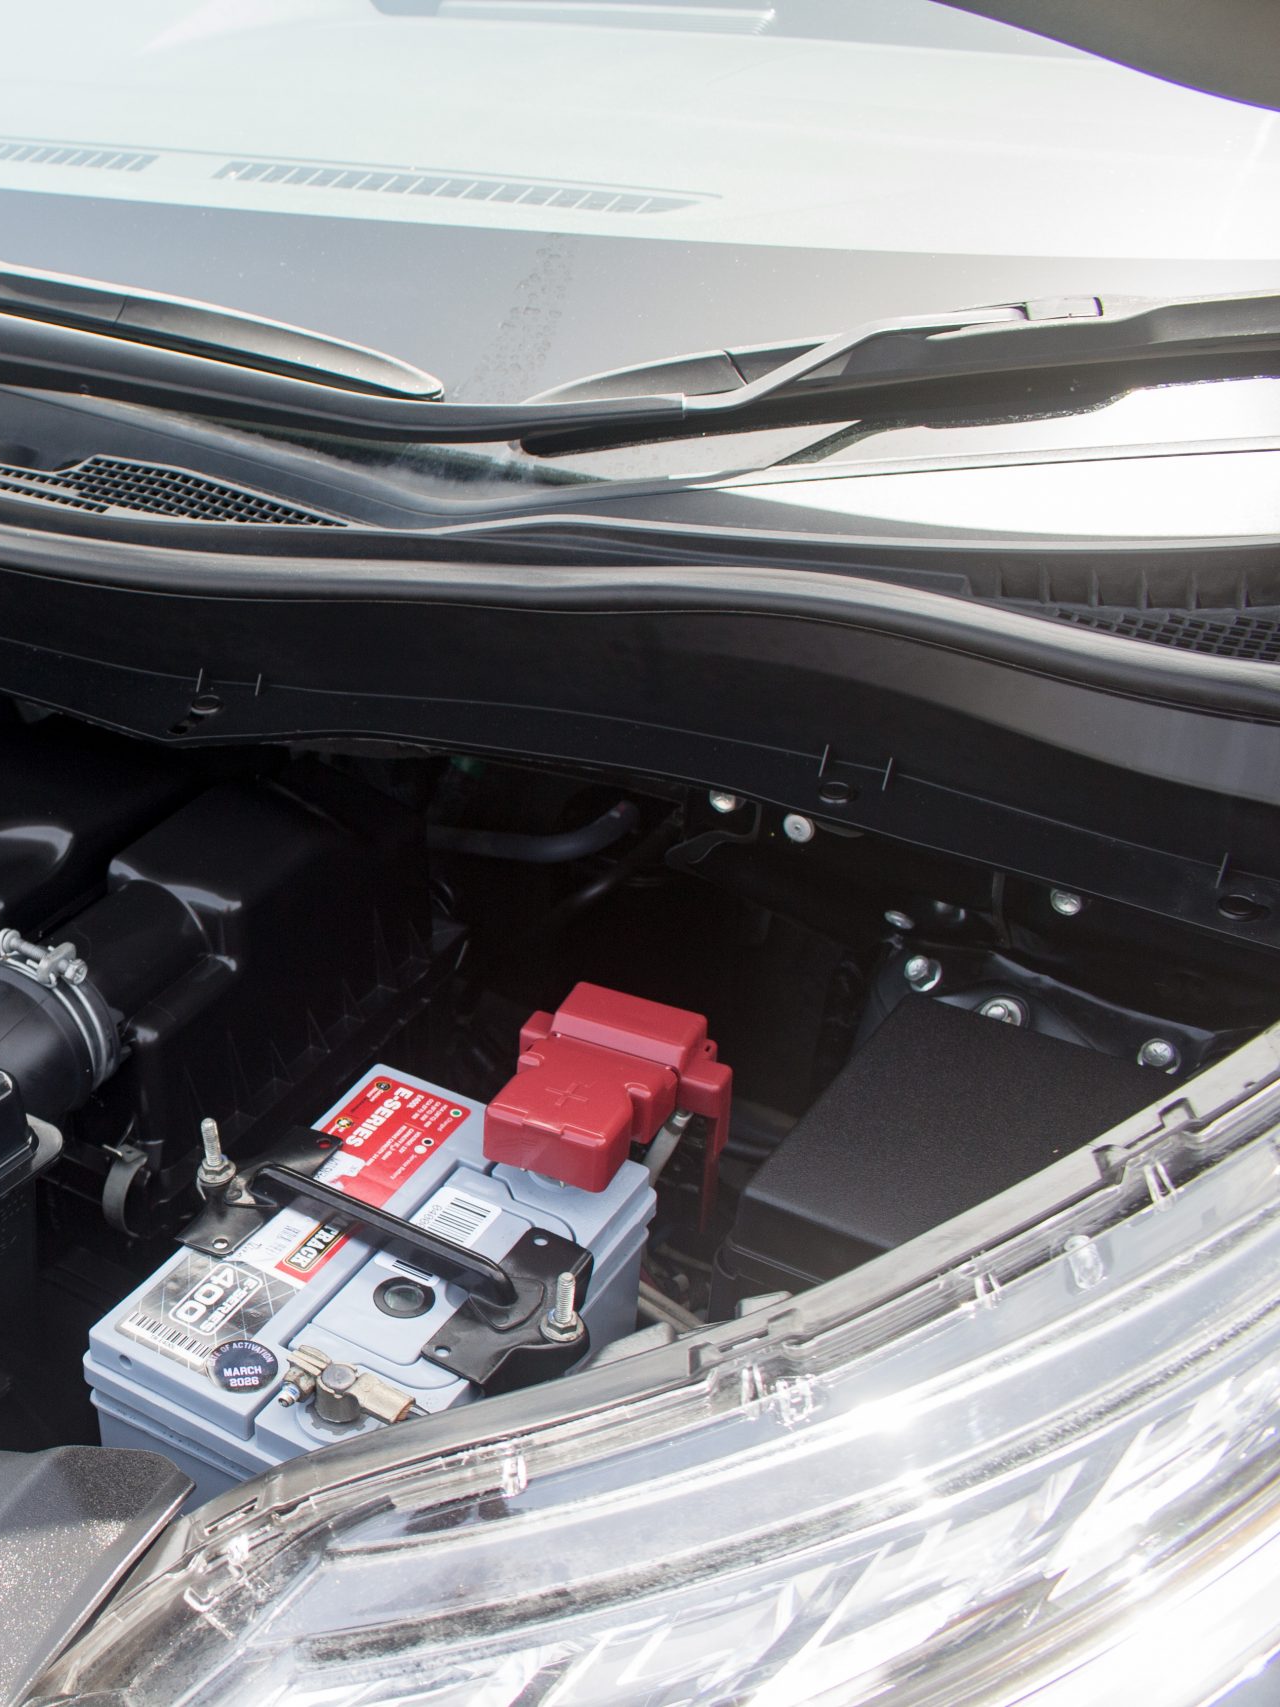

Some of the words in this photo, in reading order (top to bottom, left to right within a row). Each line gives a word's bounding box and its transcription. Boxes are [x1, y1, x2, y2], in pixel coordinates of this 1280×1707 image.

[346, 1087, 414, 1147] E-SERIES
[176, 1267, 234, 1323] 400
[199, 1278, 258, 1332] E-SERIES
[223, 1365, 262, 1377] MARCH
[232, 1342, 275, 1363] ACTIVATION
[229, 1376, 259, 1387] 2026
